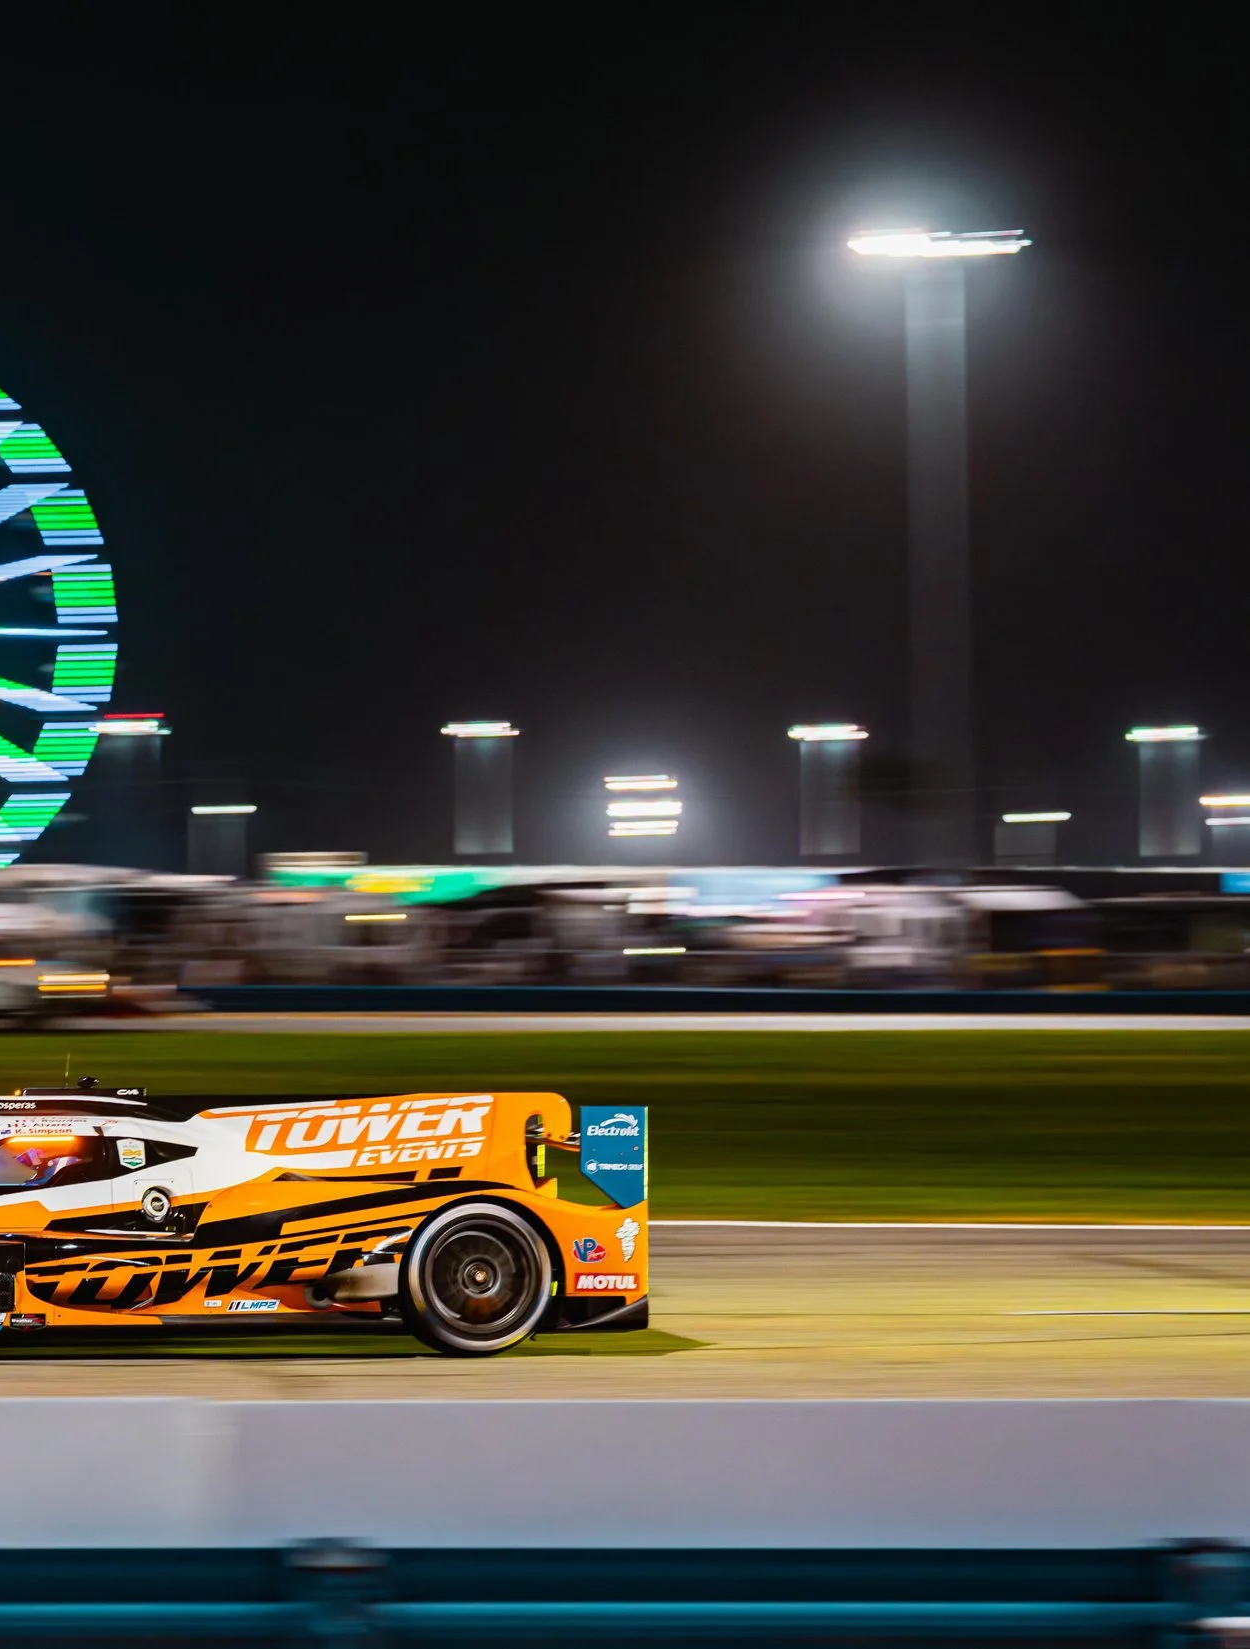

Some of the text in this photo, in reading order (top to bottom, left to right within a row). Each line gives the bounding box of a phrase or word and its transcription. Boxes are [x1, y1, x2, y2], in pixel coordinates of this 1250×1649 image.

[254, 1095, 495, 1150] TOWER
[355, 1136, 487, 1167] EVENTS
[573, 1238, 597, 1263] VP
[576, 1275, 638, 1290] MOTUL
[240, 1301, 277, 1310] LMP2
